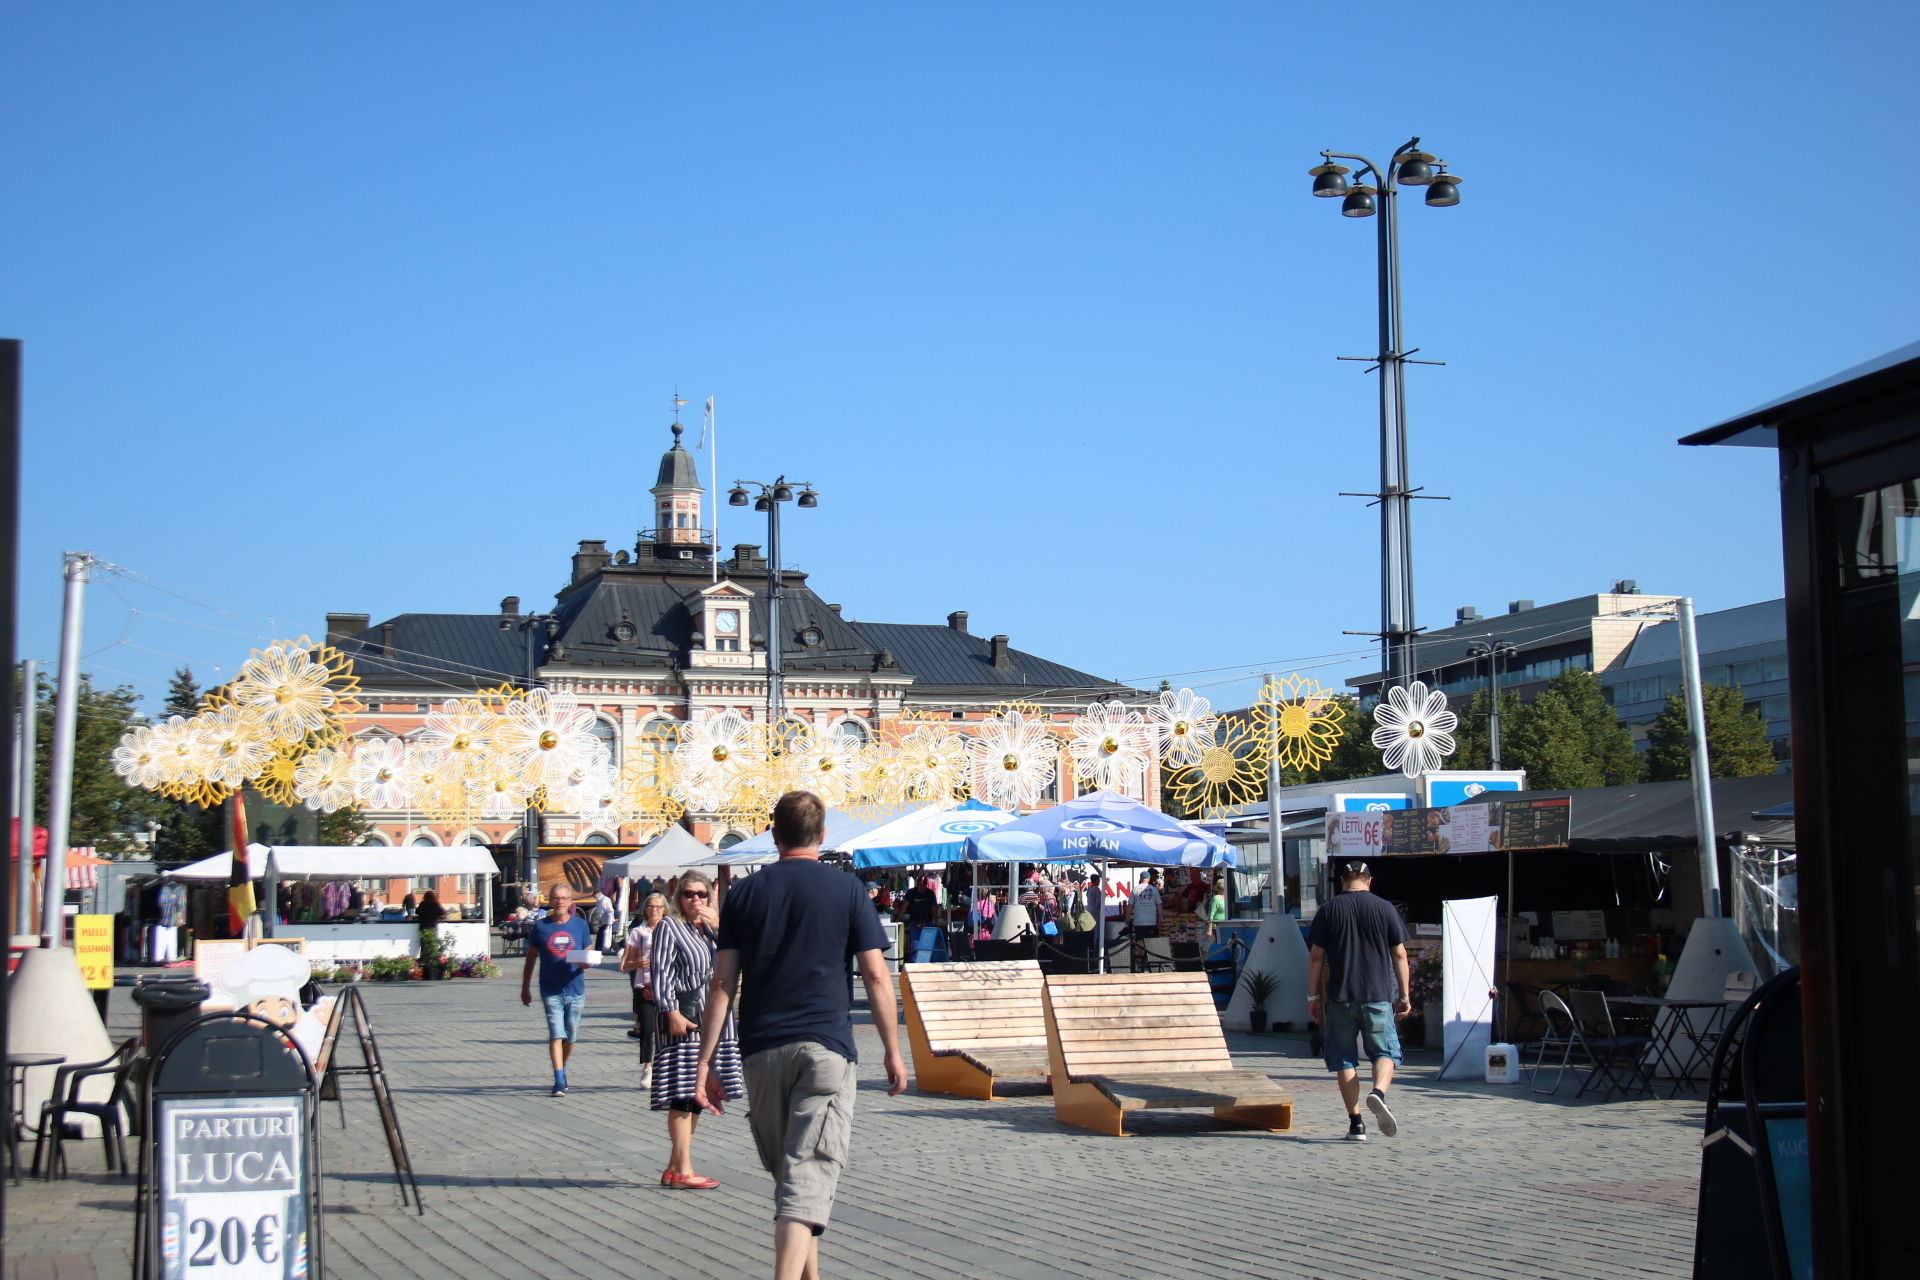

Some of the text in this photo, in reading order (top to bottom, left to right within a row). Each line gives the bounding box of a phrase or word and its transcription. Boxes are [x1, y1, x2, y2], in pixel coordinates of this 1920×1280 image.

[1341, 821, 1362, 834] LETTU
[1364, 821, 1380, 846] 6€
[1062, 836, 1120, 851] INGMAN
[82, 928, 108, 937] PAELLA
[79, 945, 112, 953] SEAFOOD
[101, 965, 110, 981] €
[179, 1116, 295, 1139] PARTURI
[178, 1150, 297, 1183] LUCA
[189, 1213, 280, 1267] 20€
